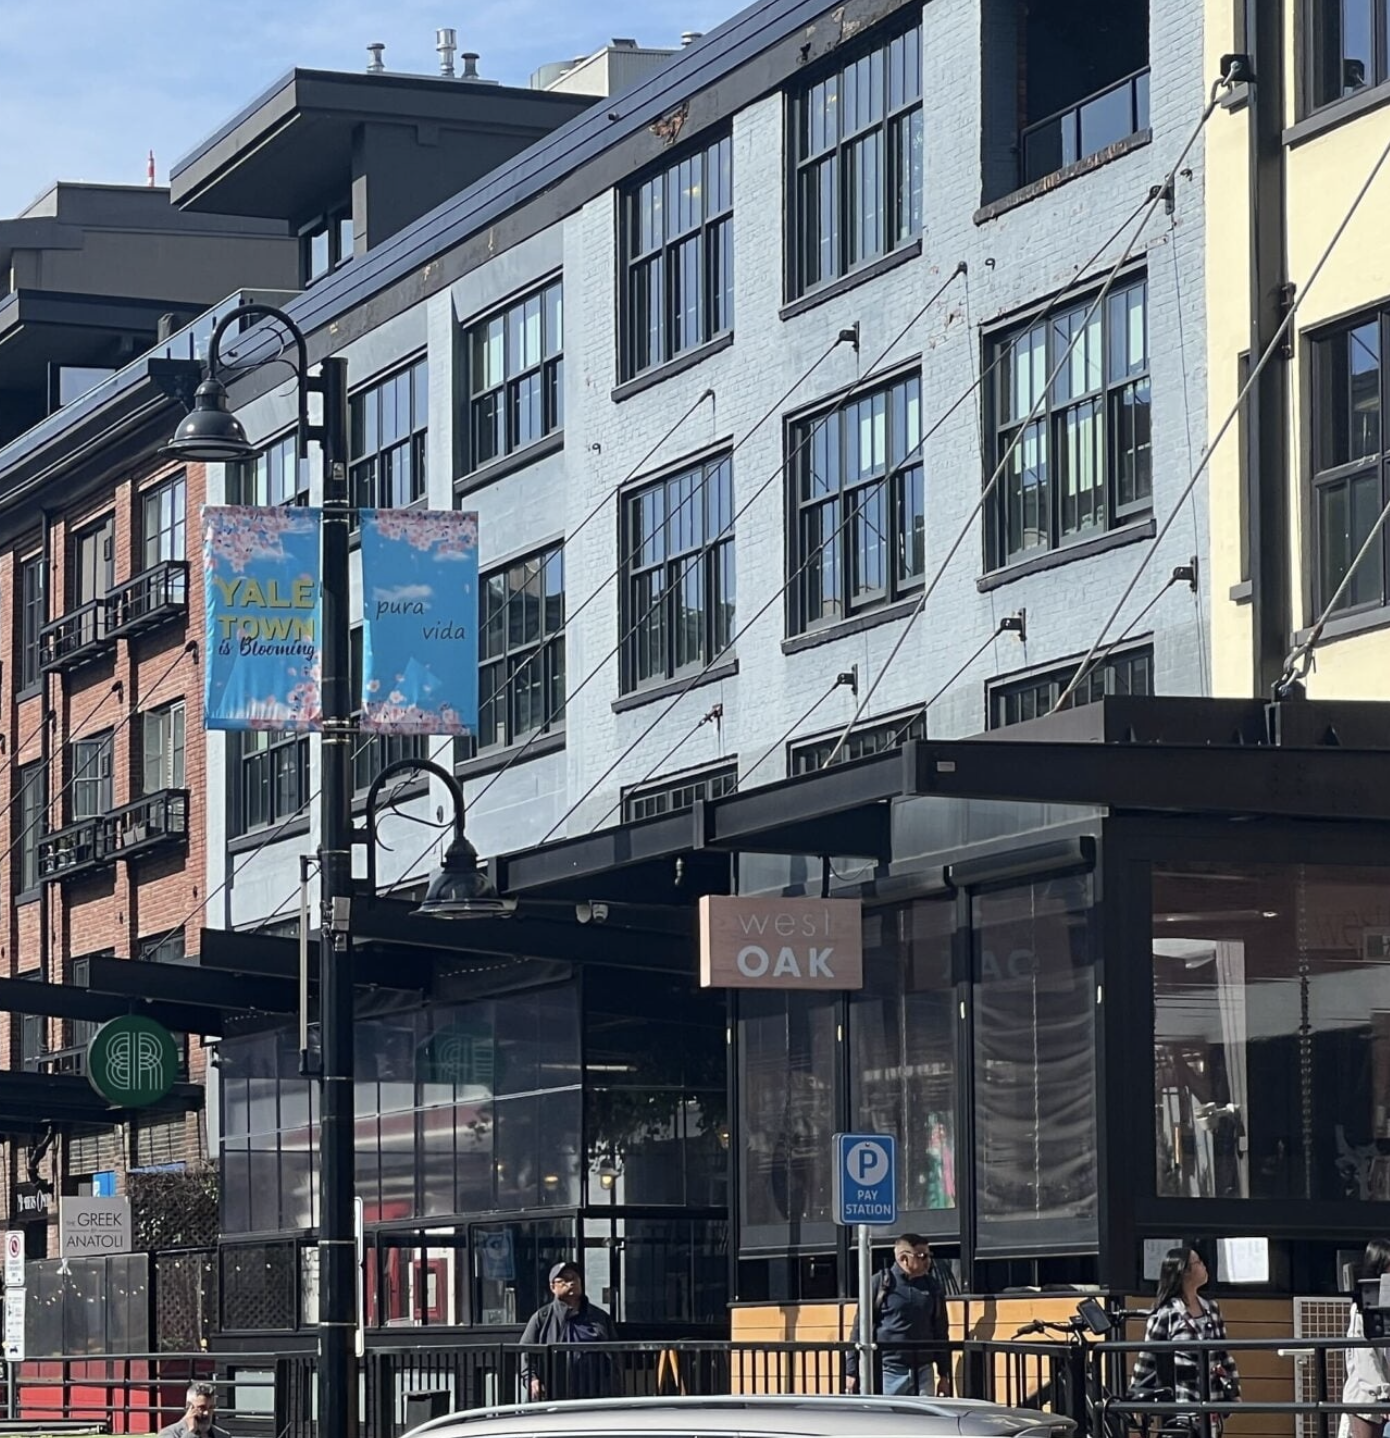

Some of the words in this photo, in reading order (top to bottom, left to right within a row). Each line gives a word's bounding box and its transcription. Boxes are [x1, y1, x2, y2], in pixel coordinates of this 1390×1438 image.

[214, 578, 315, 610] YALE
[377, 600, 425, 620] pura
[217, 615, 316, 642] TOWN
[423, 621, 466, 640] vida
[218, 639, 230, 656] is
[239, 636, 315, 661] Blooming
[737, 945, 835, 978] OAK
[857, 1189, 878, 1200] PAY
[845, 1204, 891, 1214] STATION
[77, 1212, 122, 1226] GREEK
[66, 1235, 123, 1248] ANATOLI
